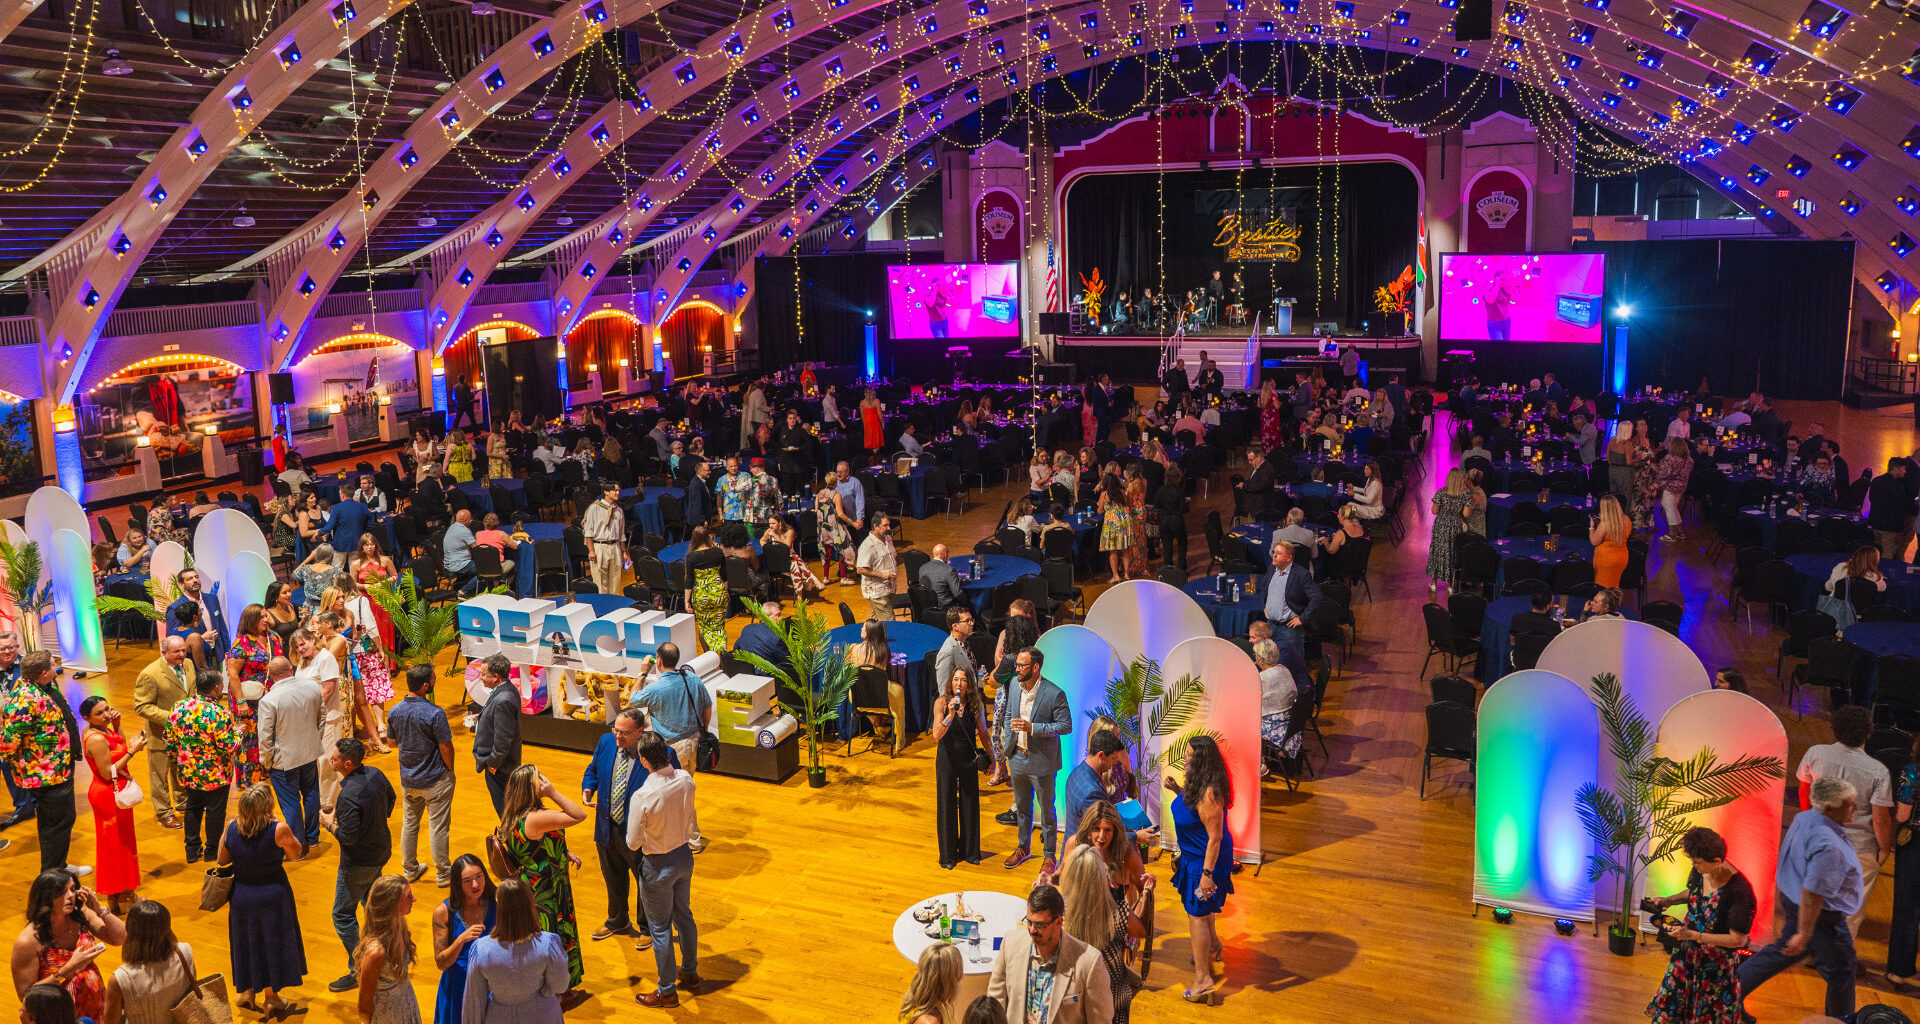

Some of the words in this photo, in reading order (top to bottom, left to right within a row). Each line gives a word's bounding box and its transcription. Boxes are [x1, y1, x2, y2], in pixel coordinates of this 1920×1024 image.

[1778, 190, 1789, 198] EXIT
[1478, 197, 1517, 208] COLISEUM
[984, 212, 1012, 221] COLISEUM
[1212, 213, 1302, 247] Besties
[458, 599, 690, 680] BEACH
